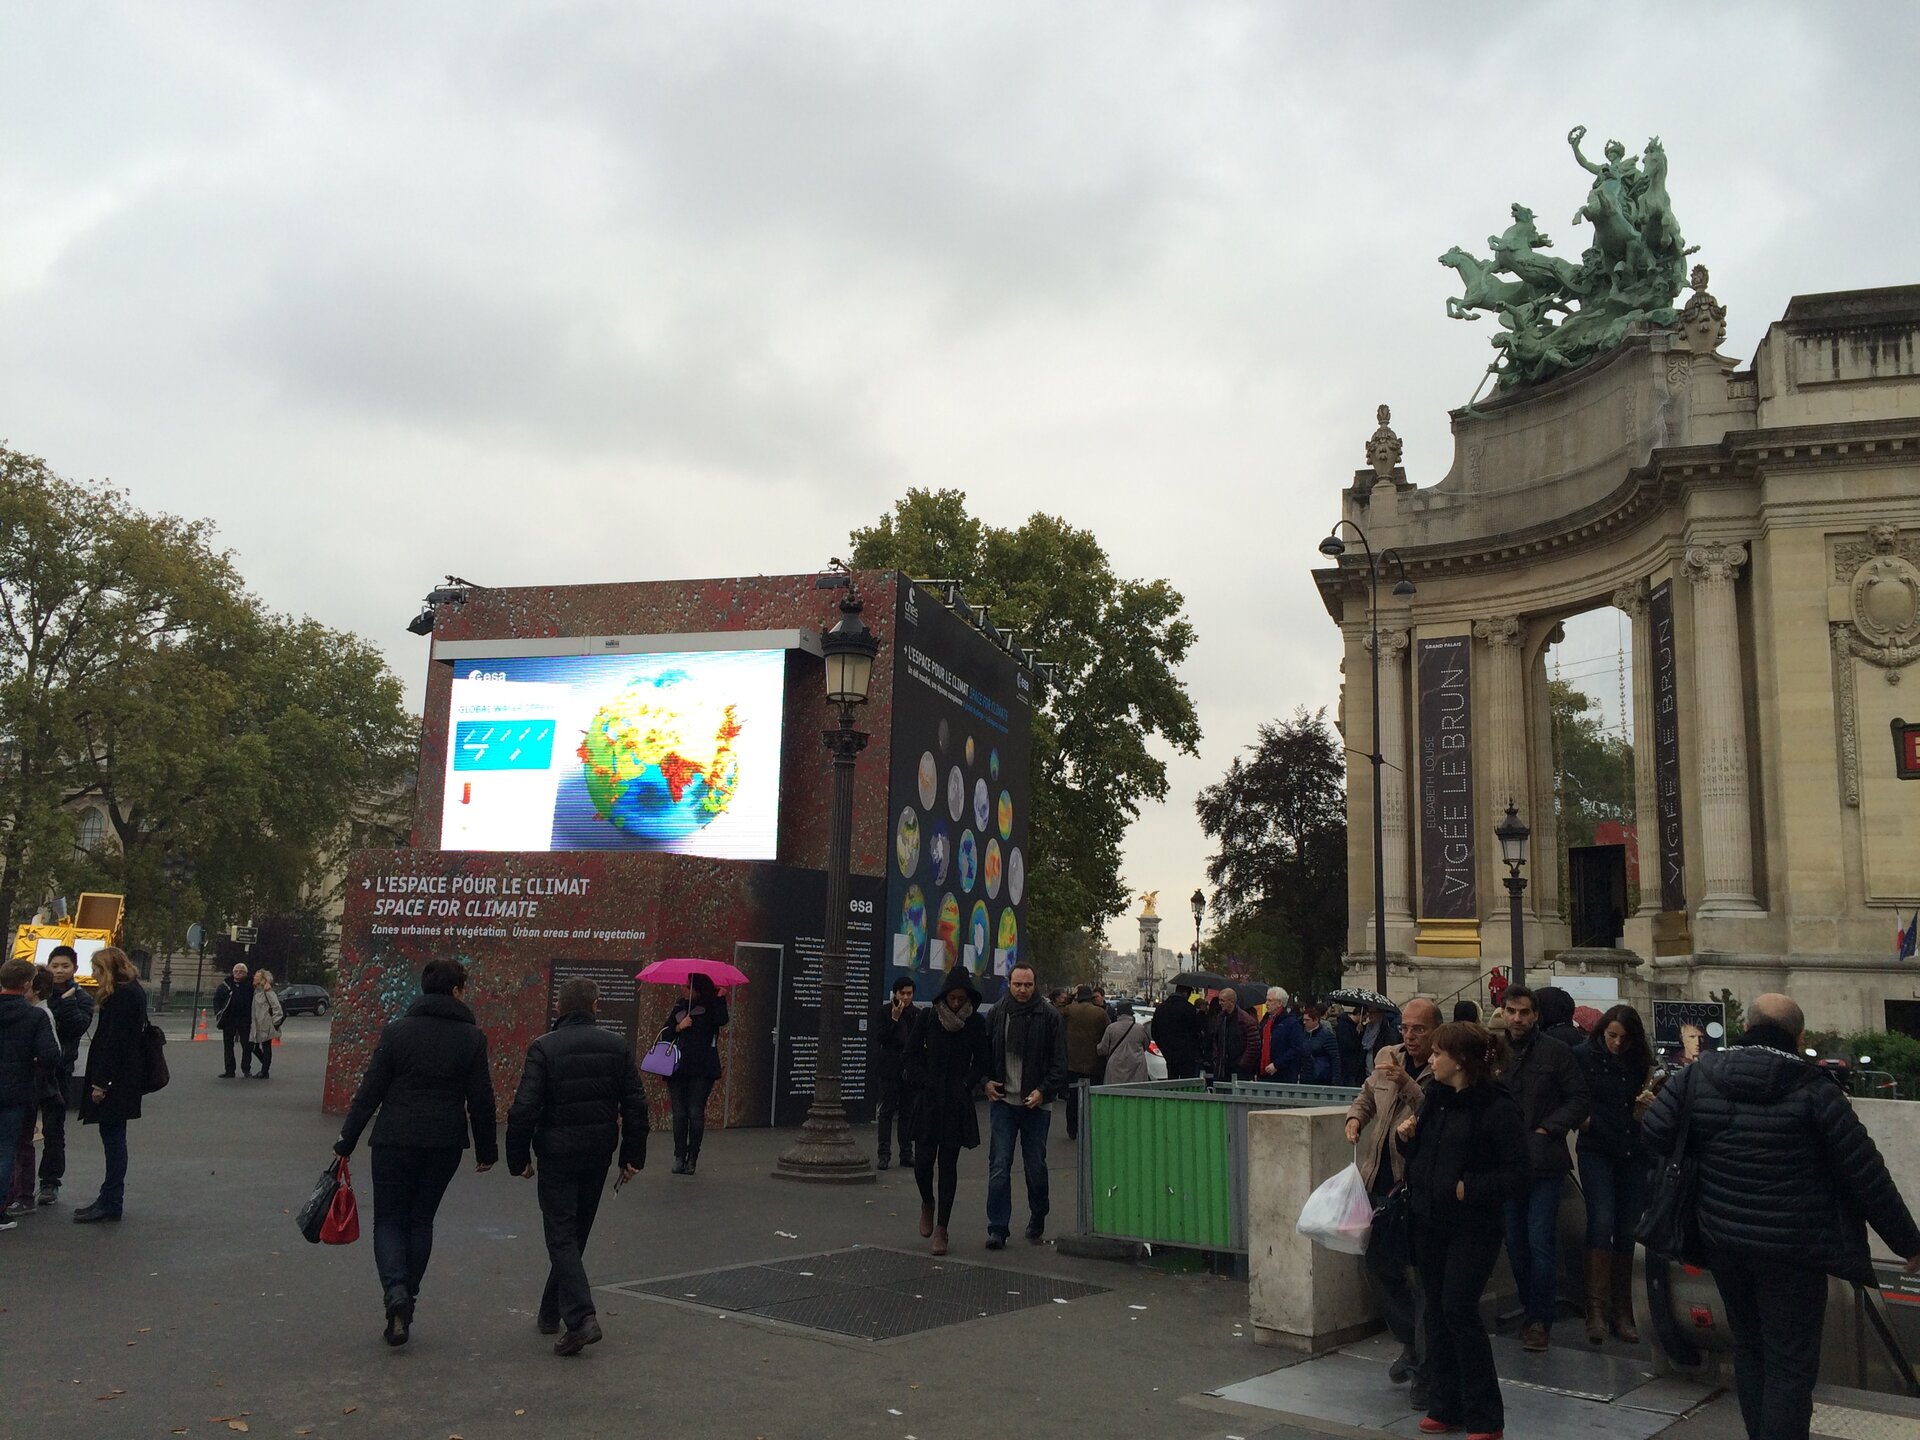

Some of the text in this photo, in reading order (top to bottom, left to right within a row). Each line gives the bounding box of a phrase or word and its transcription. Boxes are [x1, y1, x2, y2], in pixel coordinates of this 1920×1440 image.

[908, 645, 932, 673] L'ESPACE
[932, 661, 945, 681] POUR
[945, 670, 952, 686] LE
[952, 675, 970, 697] CLIMAT
[1660, 618, 1674, 714] BRUN
[1662, 726, 1675, 765] LE
[1424, 736, 1436, 829] ELISABETH LOUISE
[1438, 669, 1469, 895] VIGÉE LE BRUN
[376, 877, 590, 896] L'ESPACE POUR LE CLIMAT
[373, 899, 538, 918] SPACE FOR CLIMATE
[849, 899, 874, 914] esa
[372, 924, 646, 942] Zones urbaines et végétation Urban areas and vegetation
[1655, 1004, 1720, 1017] PICASSO
[1656, 1016, 1705, 1030] MANIA
